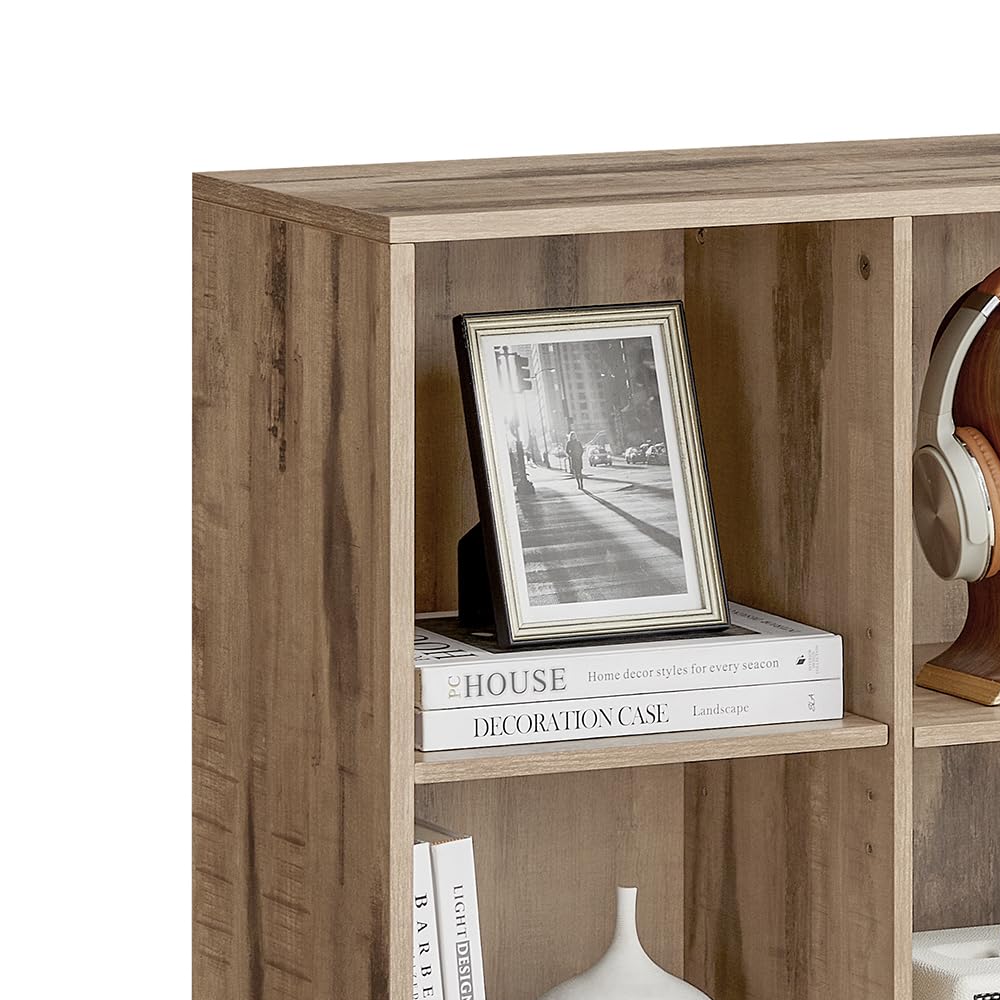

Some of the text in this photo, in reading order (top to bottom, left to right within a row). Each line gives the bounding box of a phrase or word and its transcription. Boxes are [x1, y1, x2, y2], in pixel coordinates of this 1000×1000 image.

[464, 667, 567, 698] HOUSE
[588, 658, 779, 682] Home decor styles for every seacon
[448, 675, 461, 699] PC
[473, 703, 670, 738] DECORATION CASE
[693, 703, 750, 717] Landscape
[453, 885, 468, 938] LIGHT
